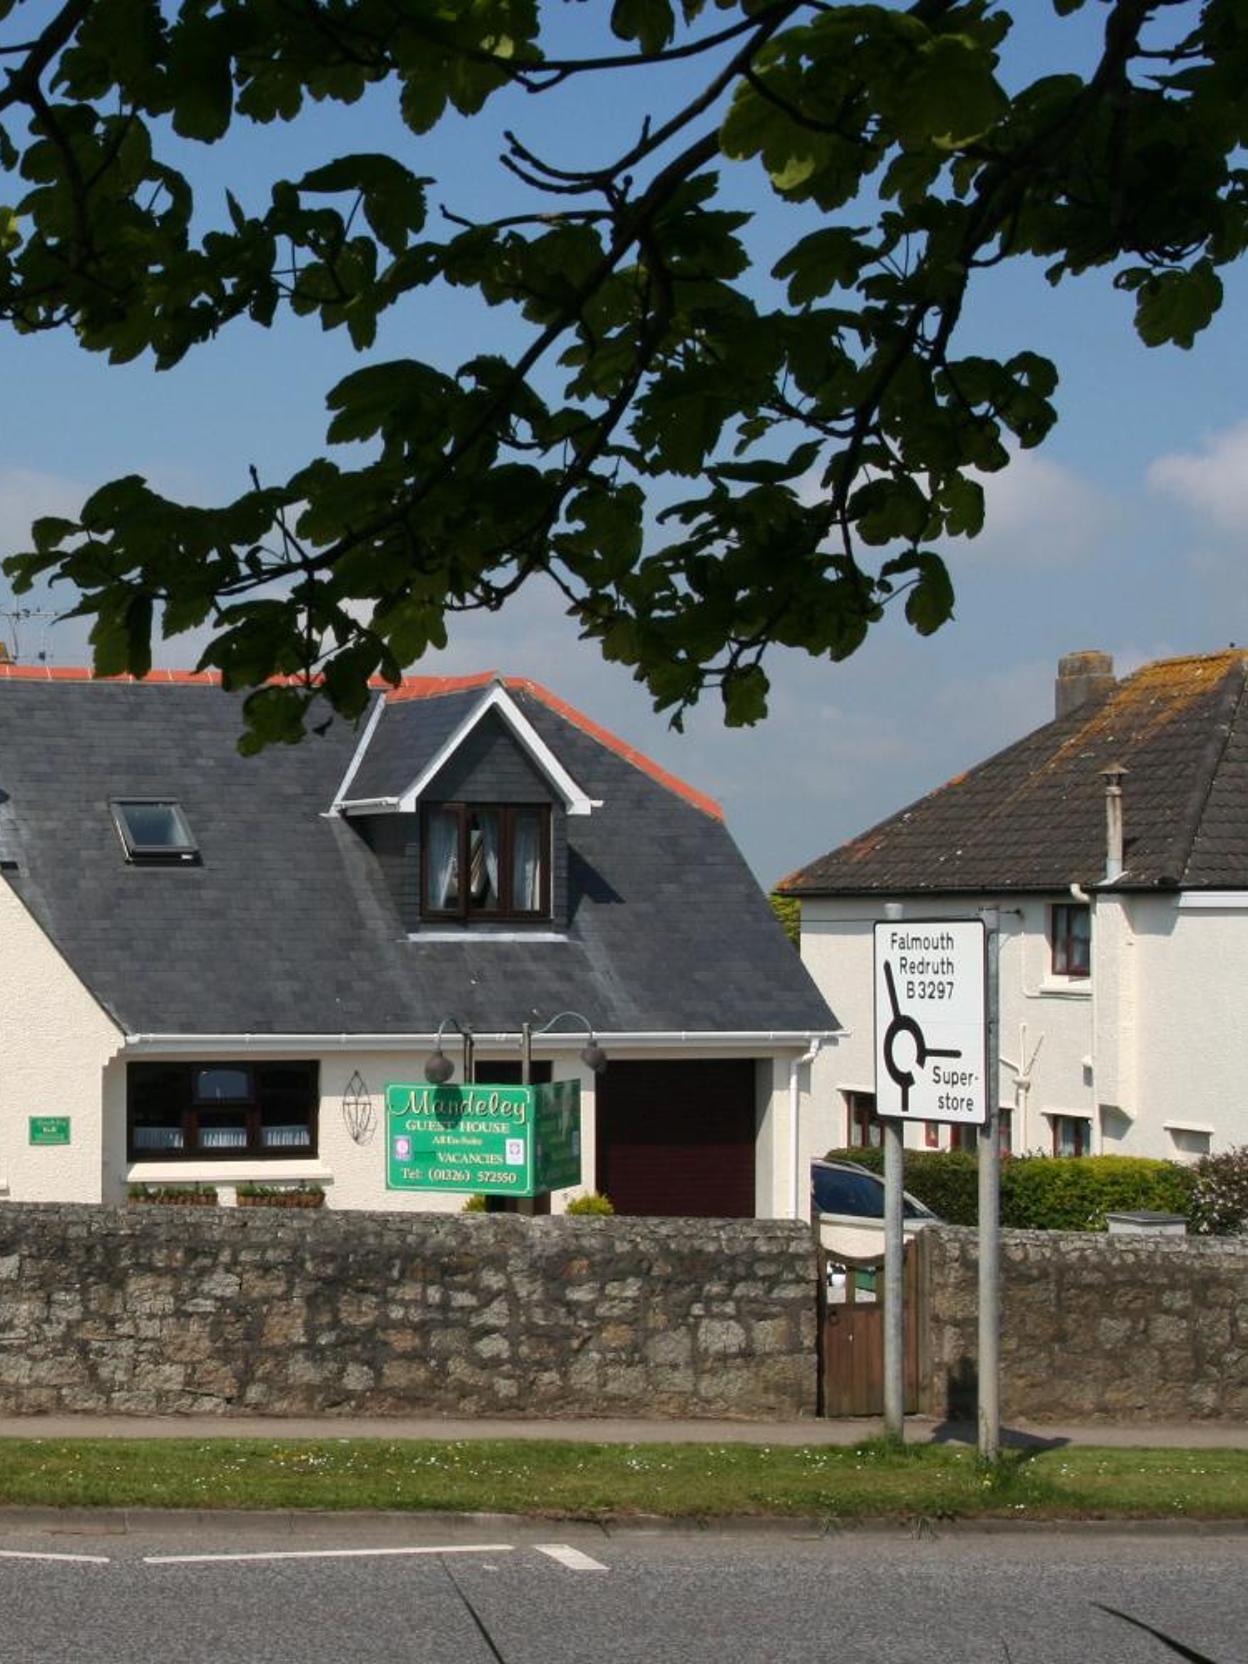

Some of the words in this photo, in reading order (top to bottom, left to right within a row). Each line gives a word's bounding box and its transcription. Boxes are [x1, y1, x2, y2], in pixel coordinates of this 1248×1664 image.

[890, 932, 954, 950] Falmouth
[899, 956, 955, 975] Redruth
[932, 1066, 979, 1088] Super-
[389, 1091, 525, 1124] Mandeley
[937, 1094, 974, 1112] store
[406, 1121, 454, 1132] GUEST
[461, 1122, 510, 1133] HOUSE
[439, 1153, 504, 1164] VACANCIES
[477, 1171, 517, 1183] 572550
